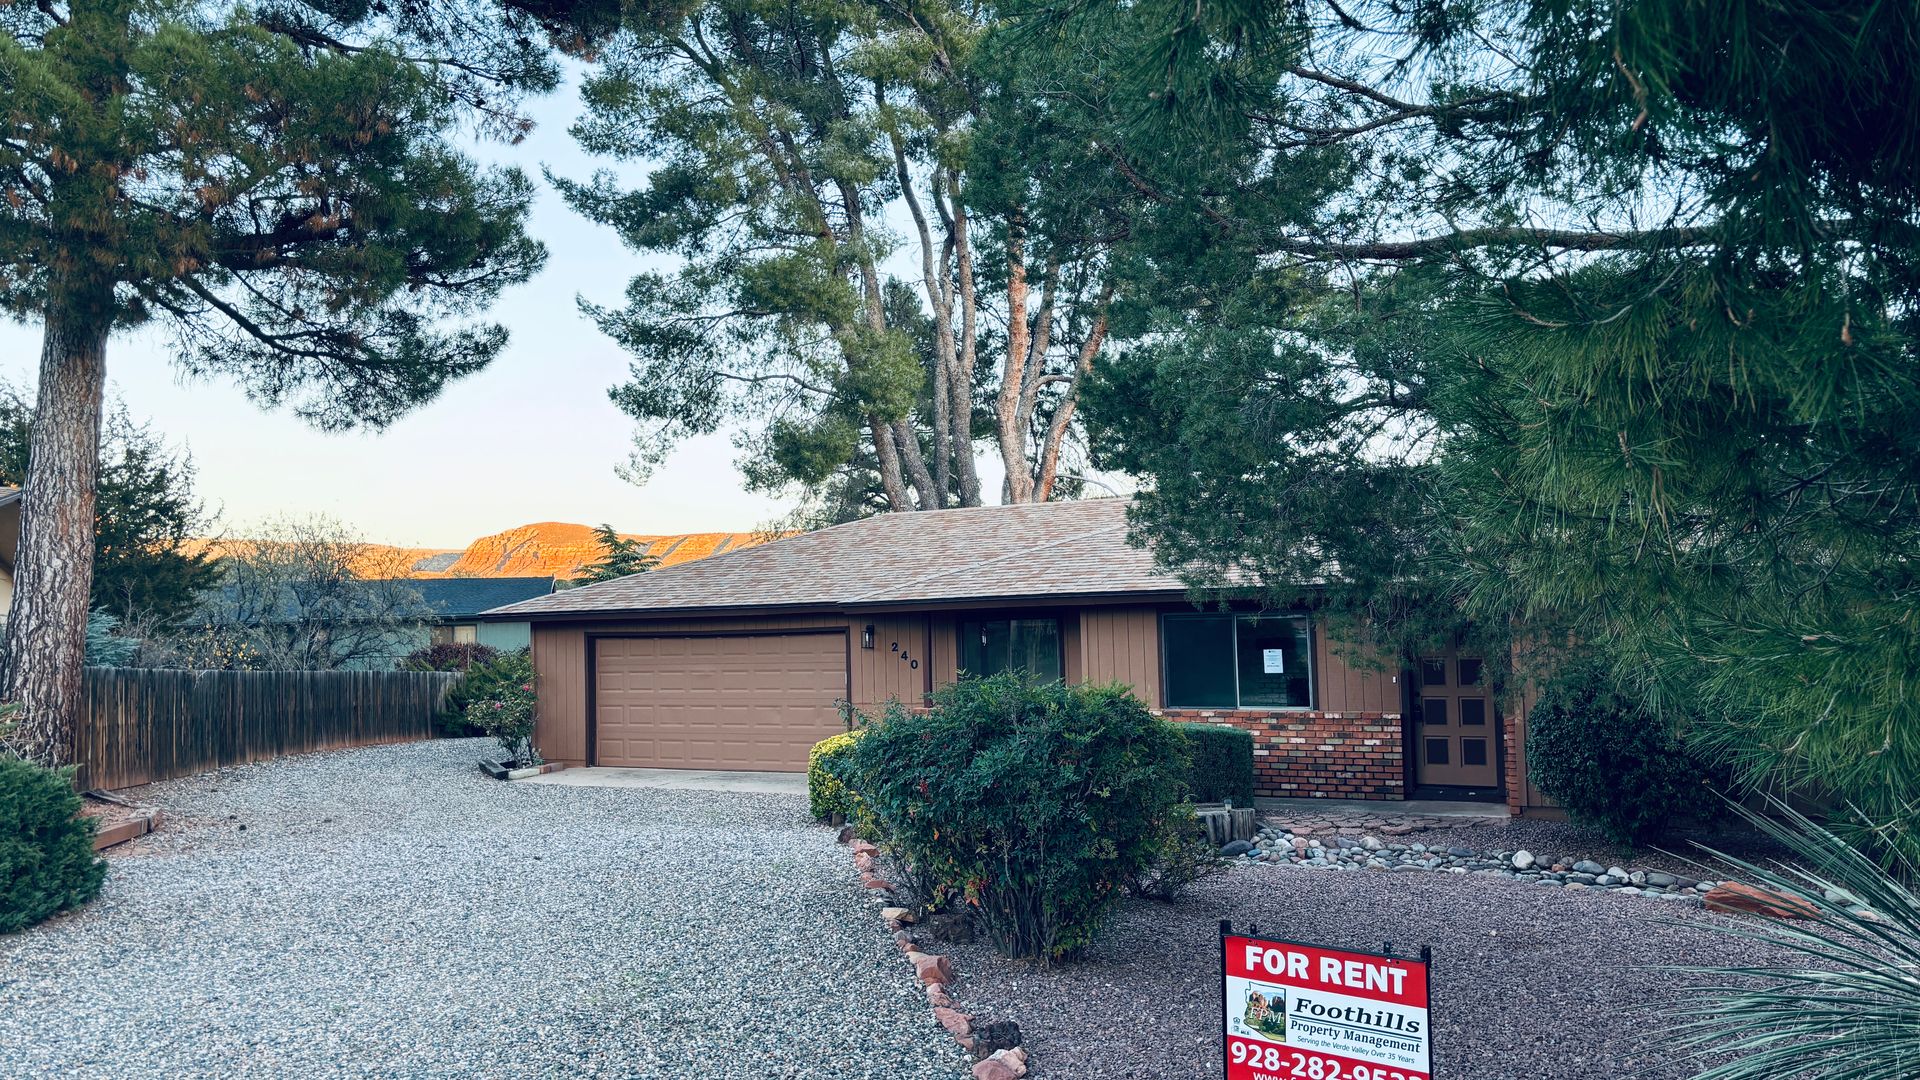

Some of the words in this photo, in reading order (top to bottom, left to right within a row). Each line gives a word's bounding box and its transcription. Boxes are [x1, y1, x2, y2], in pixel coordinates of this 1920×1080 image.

[891, 642, 918, 669] 240
[1245, 945, 1309, 980] FOR
[1319, 956, 1408, 995] RENT
[1250, 1007, 1282, 1024] FPM
[1294, 998, 1420, 1033] Foothills
[1290, 1020, 1340, 1040] Property
[1343, 1030, 1421, 1053] Management
[1297, 1035, 1319, 1047] Serving
[1332, 1042, 1350, 1051] Verde
[1351, 1045, 1369, 1056] Valley
[1371, 1049, 1386, 1058] Over
[1387, 1052, 1396, 1060] 35
[1397, 1055, 1415, 1064] Years
[1231, 1041, 1424, 1080] 928-282-95
